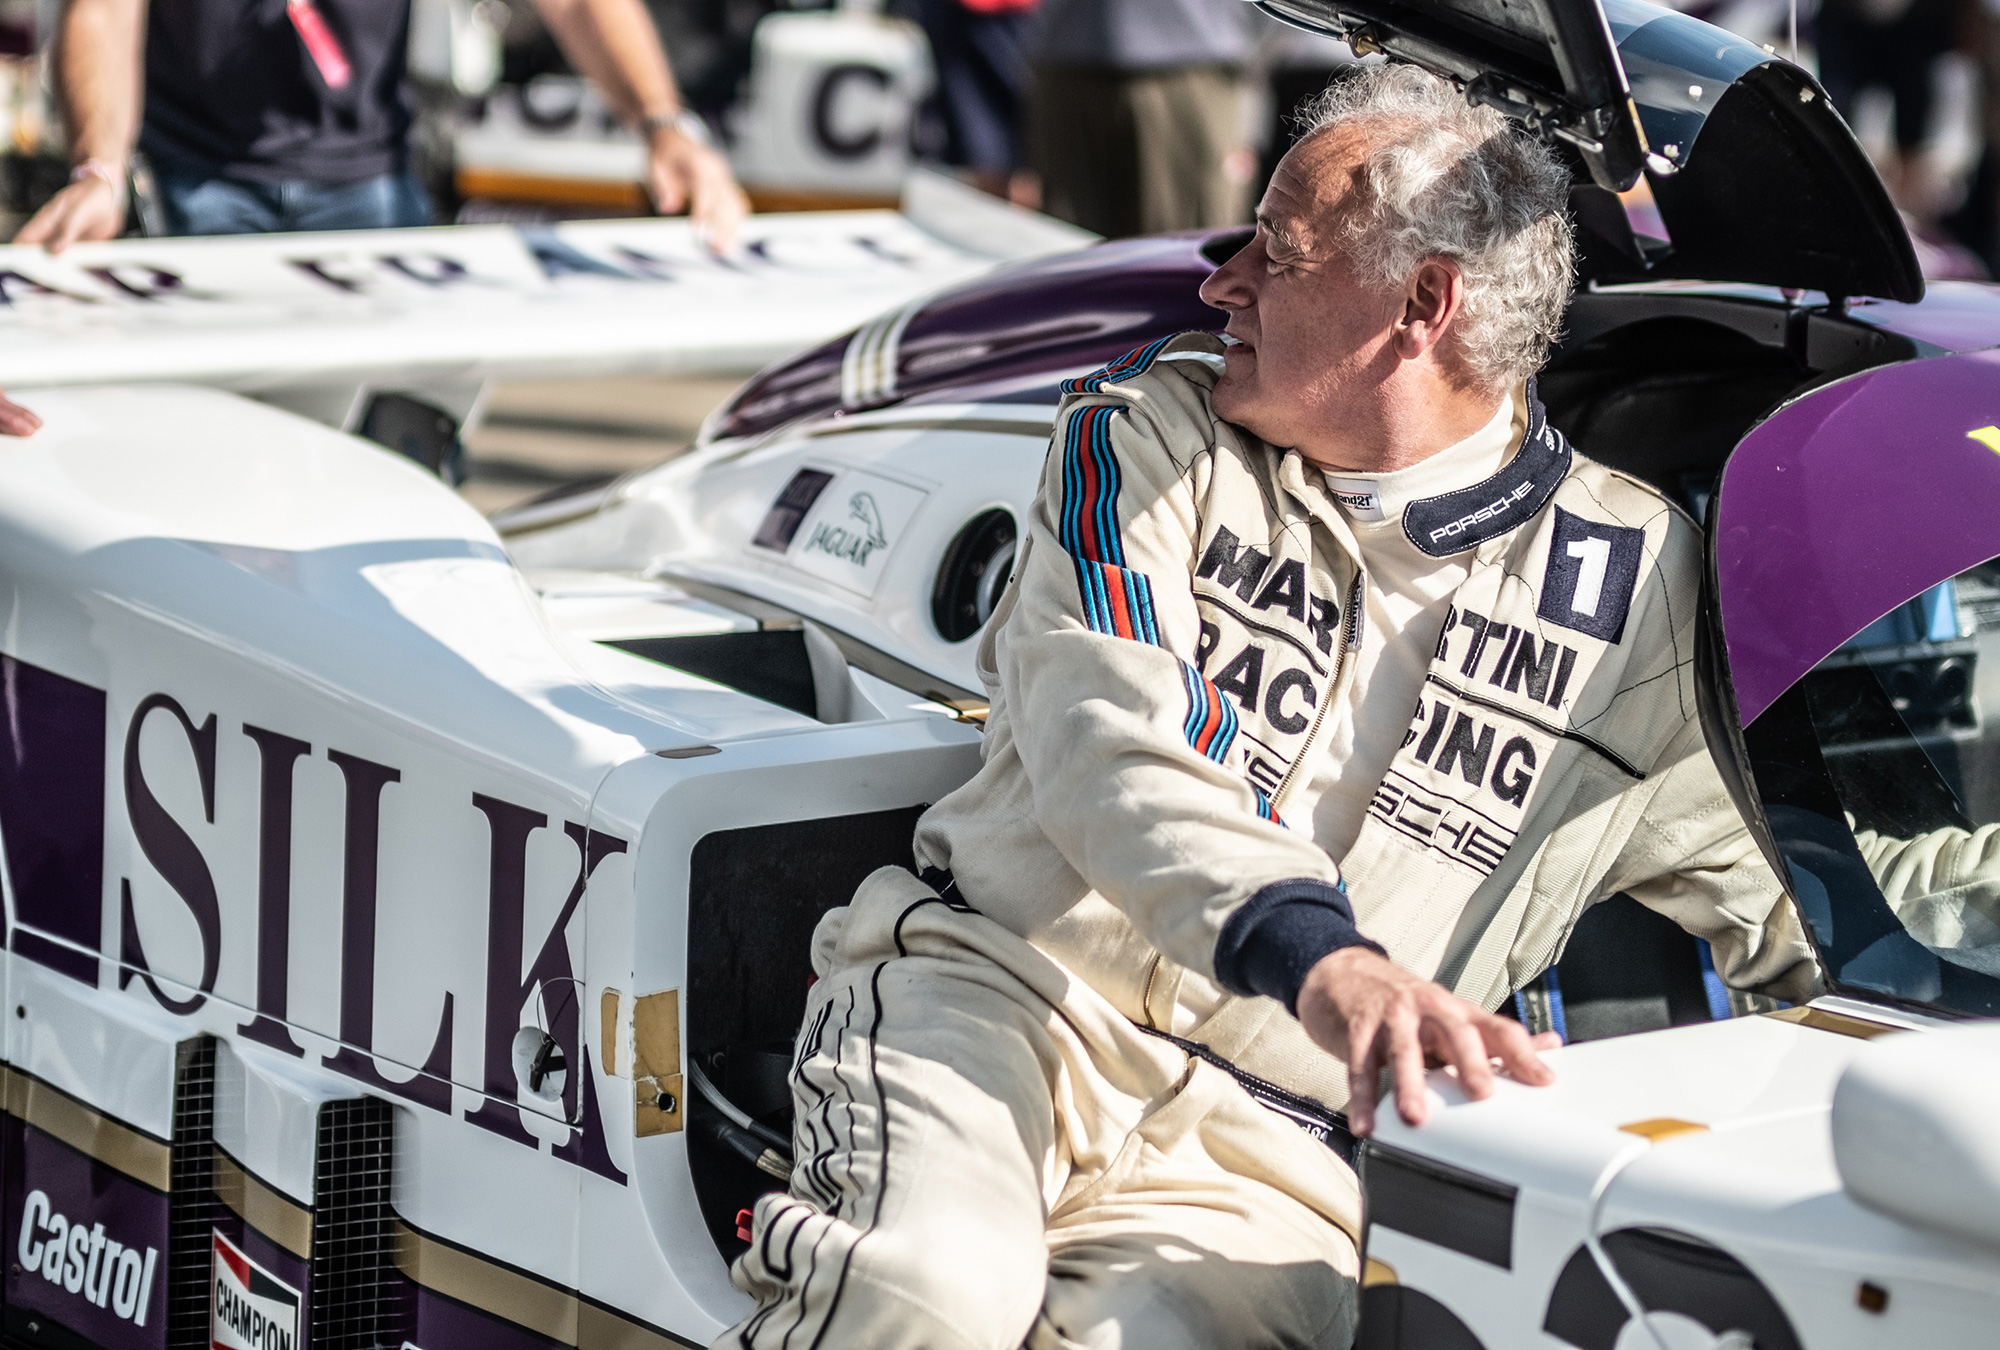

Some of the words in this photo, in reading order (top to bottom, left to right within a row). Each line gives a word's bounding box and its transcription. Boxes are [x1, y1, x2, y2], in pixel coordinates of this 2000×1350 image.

[804, 521, 874, 567] JAGUAR
[1429, 481, 1535, 543] PORSCHE
[1566, 536, 1612, 618] 1
[118, 693, 628, 1186] SILK
[18, 1190, 159, 1327] Castrol
[216, 1278, 291, 1350] CHAMPION
